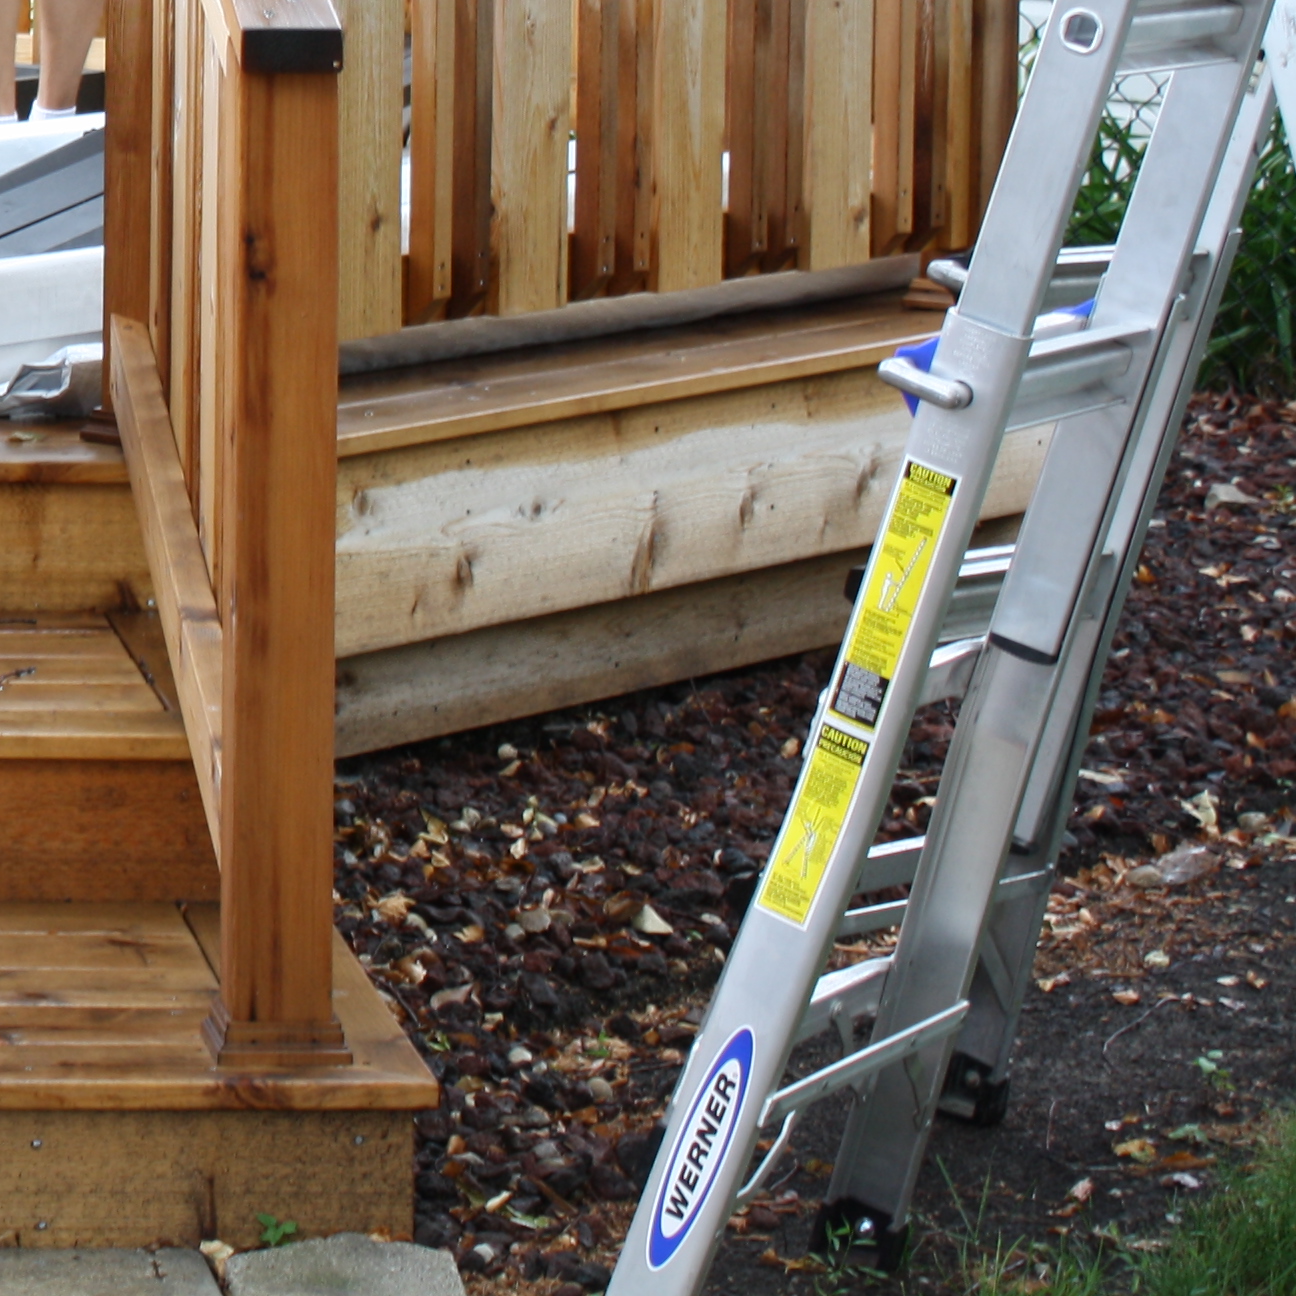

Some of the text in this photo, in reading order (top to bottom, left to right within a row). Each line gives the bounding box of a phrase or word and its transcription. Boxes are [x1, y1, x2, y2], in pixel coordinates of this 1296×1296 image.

[909, 462, 952, 488] CAUTION
[821, 724, 868, 755] CAUTION
[665, 1072, 736, 1221] WERNER
